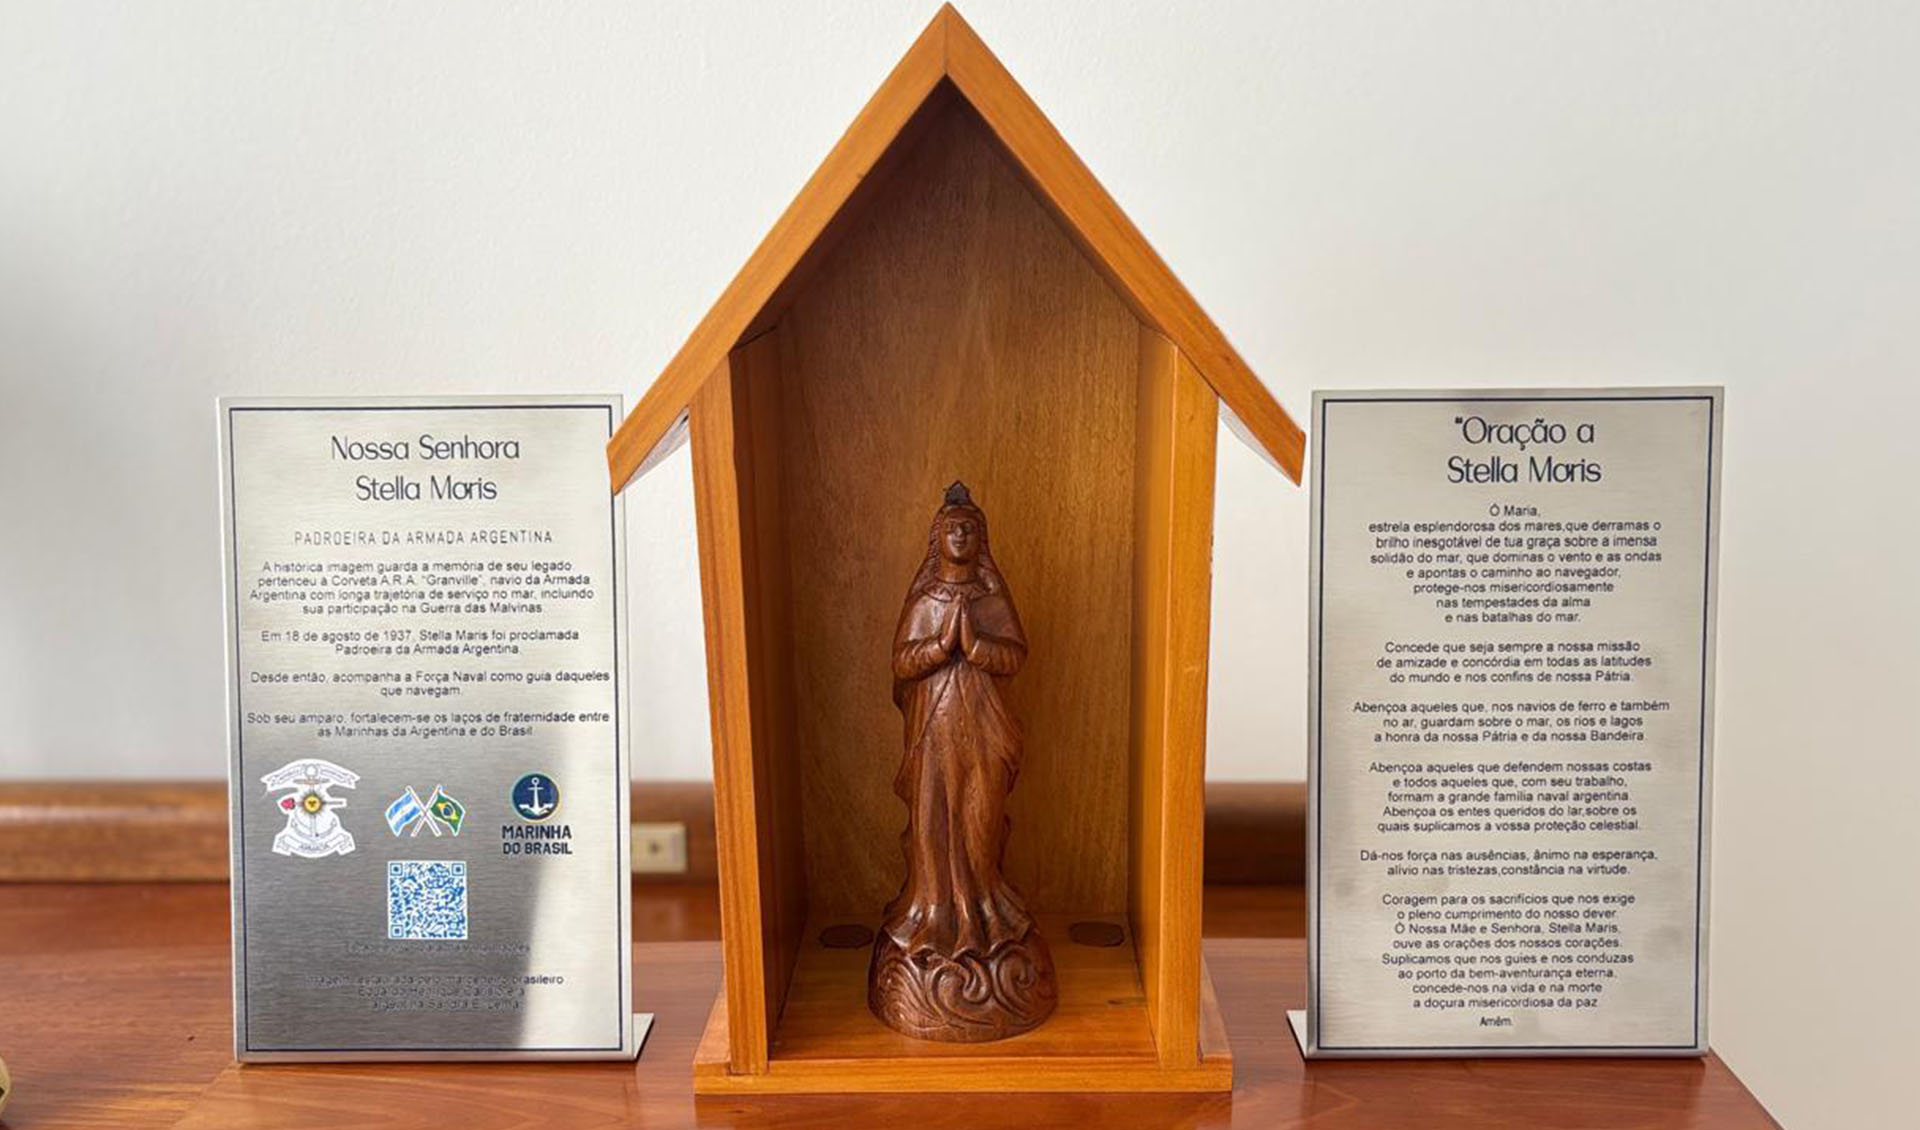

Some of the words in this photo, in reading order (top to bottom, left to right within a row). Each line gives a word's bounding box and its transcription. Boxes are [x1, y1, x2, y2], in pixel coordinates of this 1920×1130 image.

[1577, 423, 1595, 444] a
[331, 435, 409, 460] Nossa
[418, 434, 520, 460] Senhora
[1447, 455, 1518, 484] Stella
[1529, 455, 1602, 483] Maris
[356, 475, 420, 501] Stella
[430, 475, 498, 500] Maris
[1368, 520, 1410, 532] estrela
[1412, 520, 1495, 534] esplendorosa
[1498, 519, 1521, 531] dos
[1591, 519, 1650, 530] derramas
[1652, 521, 1661, 530] o
[294, 531, 376, 546] PADROEIRA
[382, 531, 400, 545] DA
[406, 530, 464, 544] ARMADA
[470, 529, 553, 544] ARGENTINA
[1376, 536, 1410, 548] brilho
[1412, 535, 1482, 550] inesgotável
[1484, 535, 1501, 547] de
[1503, 536, 1524, 547] tua
[1526, 537, 1561, 549] graça
[1563, 535, 1598, 546] sobre
[1601, 537, 1610, 546] a
[1612, 534, 1657, 546] imensa
[1370, 551, 1414, 563] solidão
[1416, 551, 1433, 562] do
[1435, 553, 1463, 564] mar,
[1465, 553, 1489, 565] que
[1491, 550, 1544, 562] dominas
[1546, 553, 1555, 562] o
[1557, 551, 1592, 562] vento
[1594, 552, 1603, 561] e
[1605, 552, 1621, 561] as
[1624, 549, 1662, 561] ondas
[262, 560, 272, 571] A
[273, 560, 323, 571] histórica
[326, 560, 374, 574] imagem
[376, 560, 418, 574] guarda
[420, 562, 429, 571] a
[431, 559, 484, 571] memória
[486, 560, 503, 571] de
[505, 562, 528, 571] seu
[1406, 568, 1415, 578] e
[1417, 567, 1467, 580] apontas
[1469, 568, 1478, 577] o
[1480, 565, 1533, 577] caminho
[1535, 568, 1551, 577] ao
[1554, 565, 1621, 579] navegador,
[250, 588, 307, 602] Argentina
[309, 591, 335, 600] com
[337, 588, 371, 602] longa
[373, 588, 425, 602] trajetória
[428, 588, 444, 599] de
[446, 588, 489, 602] serviço
[492, 590, 508, 599] no
[510, 590, 537, 601] mar,
[539, 588, 594, 599] incluindo
[1413, 582, 1487, 595] protege-nos
[1489, 580, 1614, 592] misericordiosamente
[1436, 598, 1459, 607] nas
[1461, 596, 1539, 610] tempestades
[1542, 595, 1558, 607] da
[1560, 595, 1590, 607] alma
[1444, 613, 1453, 622] e
[1455, 613, 1479, 622] nas
[1481, 610, 1533, 622] batalhas
[1535, 610, 1552, 622] do
[1554, 613, 1581, 622] mar.
[261, 630, 282, 641] Em
[302, 629, 319, 641] de
[321, 630, 361, 643] agosto
[363, 629, 380, 641] de
[418, 629, 452, 640] Stella
[454, 629, 489, 640] Maris
[491, 629, 506, 640] foi
[508, 629, 579, 643] proclamada
[1385, 641, 1440, 652] Concede
[1442, 643, 1466, 655] que
[1468, 640, 1495, 655] seja
[1497, 643, 1543, 655] sempre
[1546, 643, 1554, 652] a
[1557, 643, 1594, 652] nossa
[1596, 640, 1640, 652] missão
[1376, 656, 1393, 668] de
[1395, 656, 1448, 667] amizade
[1450, 658, 1459, 667] e
[1461, 655, 1521, 667] concórdia
[1523, 658, 1543, 667] em
[1546, 655, 1580, 667] todas
[1582, 657, 1598, 667] as
[1600, 655, 1651, 666] latitudes
[251, 670, 289, 682] Desde
[291, 670, 330, 683] então,
[332, 670, 401, 684] acompanha
[403, 673, 413, 682] a
[415, 671, 450, 684] Força
[452, 670, 487, 681] Naval
[489, 672, 523, 681] como
[525, 670, 552, 684] guia
[554, 670, 610, 684] daqueles
[380, 687, 403, 698] que
[405, 686, 463, 698] navegam.
[247, 711, 271, 723] Sob
[273, 714, 296, 723] seu
[350, 711, 431, 722] fortalecem-se
[433, 713, 448, 722] os
[450, 711, 483, 725] laços
[485, 711, 501, 722] de
[503, 711, 576, 722] fraternidade
[578, 711, 610, 722] entre
[1369, 761, 1423, 775] Abençoa
[1426, 760, 1474, 775] aqueles
[1476, 763, 1500, 775] que
[1502, 760, 1563, 772] defendem
[1565, 762, 1609, 772] nossas
[1612, 761, 1652, 771] costas
[502, 825, 572, 839] MARINHA
[503, 842, 520, 855] DO
[524, 842, 573, 855] BRASIL
[1360, 849, 1404, 861] Dá-nos
[1406, 849, 1438, 863] força
[1440, 851, 1463, 860] nas
[1465, 849, 1530, 862] ausências,
[1532, 848, 1570, 860] ânimo
[1572, 851, 1588, 860] na
[1387, 863, 1419, 875] alívio
[1421, 866, 1445, 875] nas
[1567, 866, 1583, 875] na
[1586, 863, 1630, 875] virtude.
[1382, 893, 1438, 907] Coragem
[1440, 895, 1468, 907] para
[1470, 895, 1486, 904] os
[1488, 893, 1549, 904] sacrifícios
[1551, 895, 1575, 907] que
[1577, 895, 1600, 904] nos
[1602, 892, 1636, 907] exige
[1382, 952, 1451, 966] Suplicamos
[1453, 955, 1477, 966] que
[1479, 954, 1502, 964] nos
[1504, 952, 1538, 966] guies
[1540, 954, 1549, 963] e
[1551, 954, 1574, 963] nos
[1576, 952, 1634, 963] conduzas
